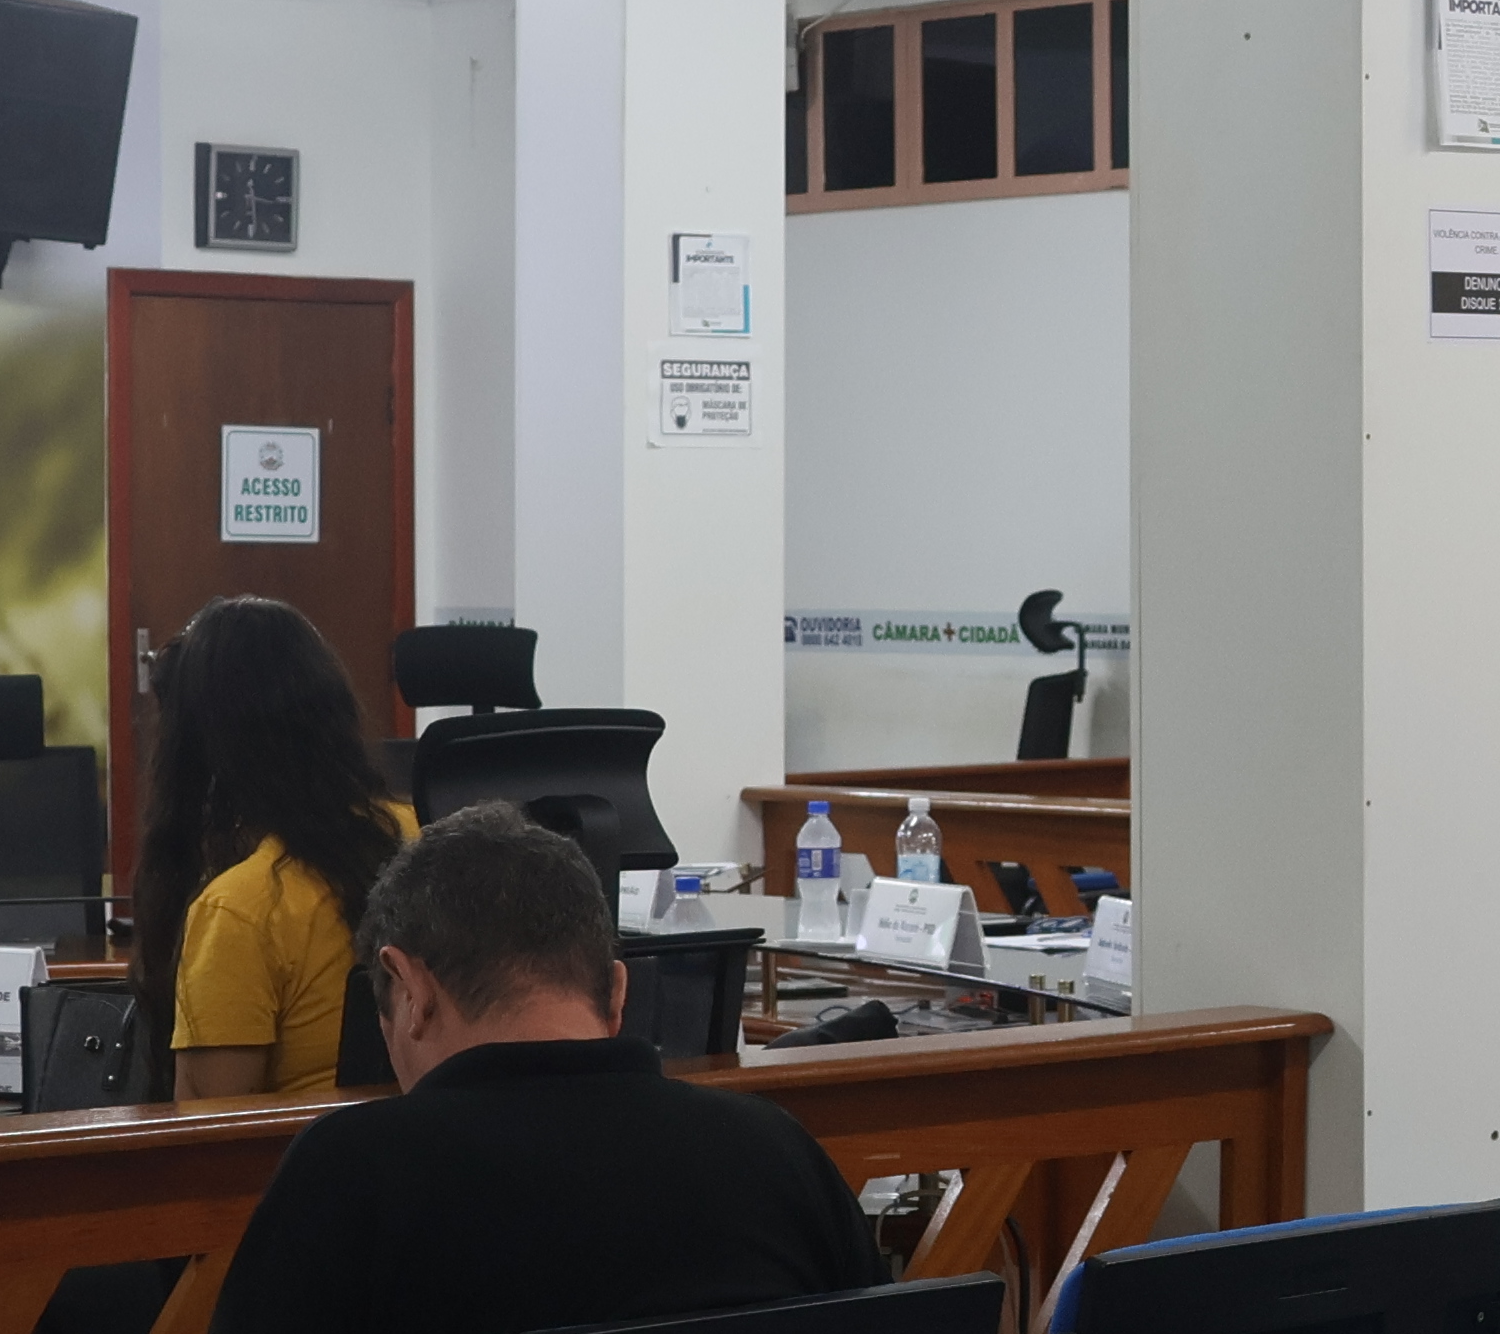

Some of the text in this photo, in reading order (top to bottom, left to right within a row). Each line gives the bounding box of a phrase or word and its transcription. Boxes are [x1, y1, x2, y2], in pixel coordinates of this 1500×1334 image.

[1433, 228, 1470, 239] VIOLÊNCIA
[1461, 296, 1497, 310] DISQUE
[663, 363, 750, 382] SEGURANÇA
[241, 477, 301, 497] ACESSO
[234, 504, 308, 524] RESTRITO
[800, 617, 862, 632] OUVIDORIA
[872, 622, 941, 642] CÂMARA
